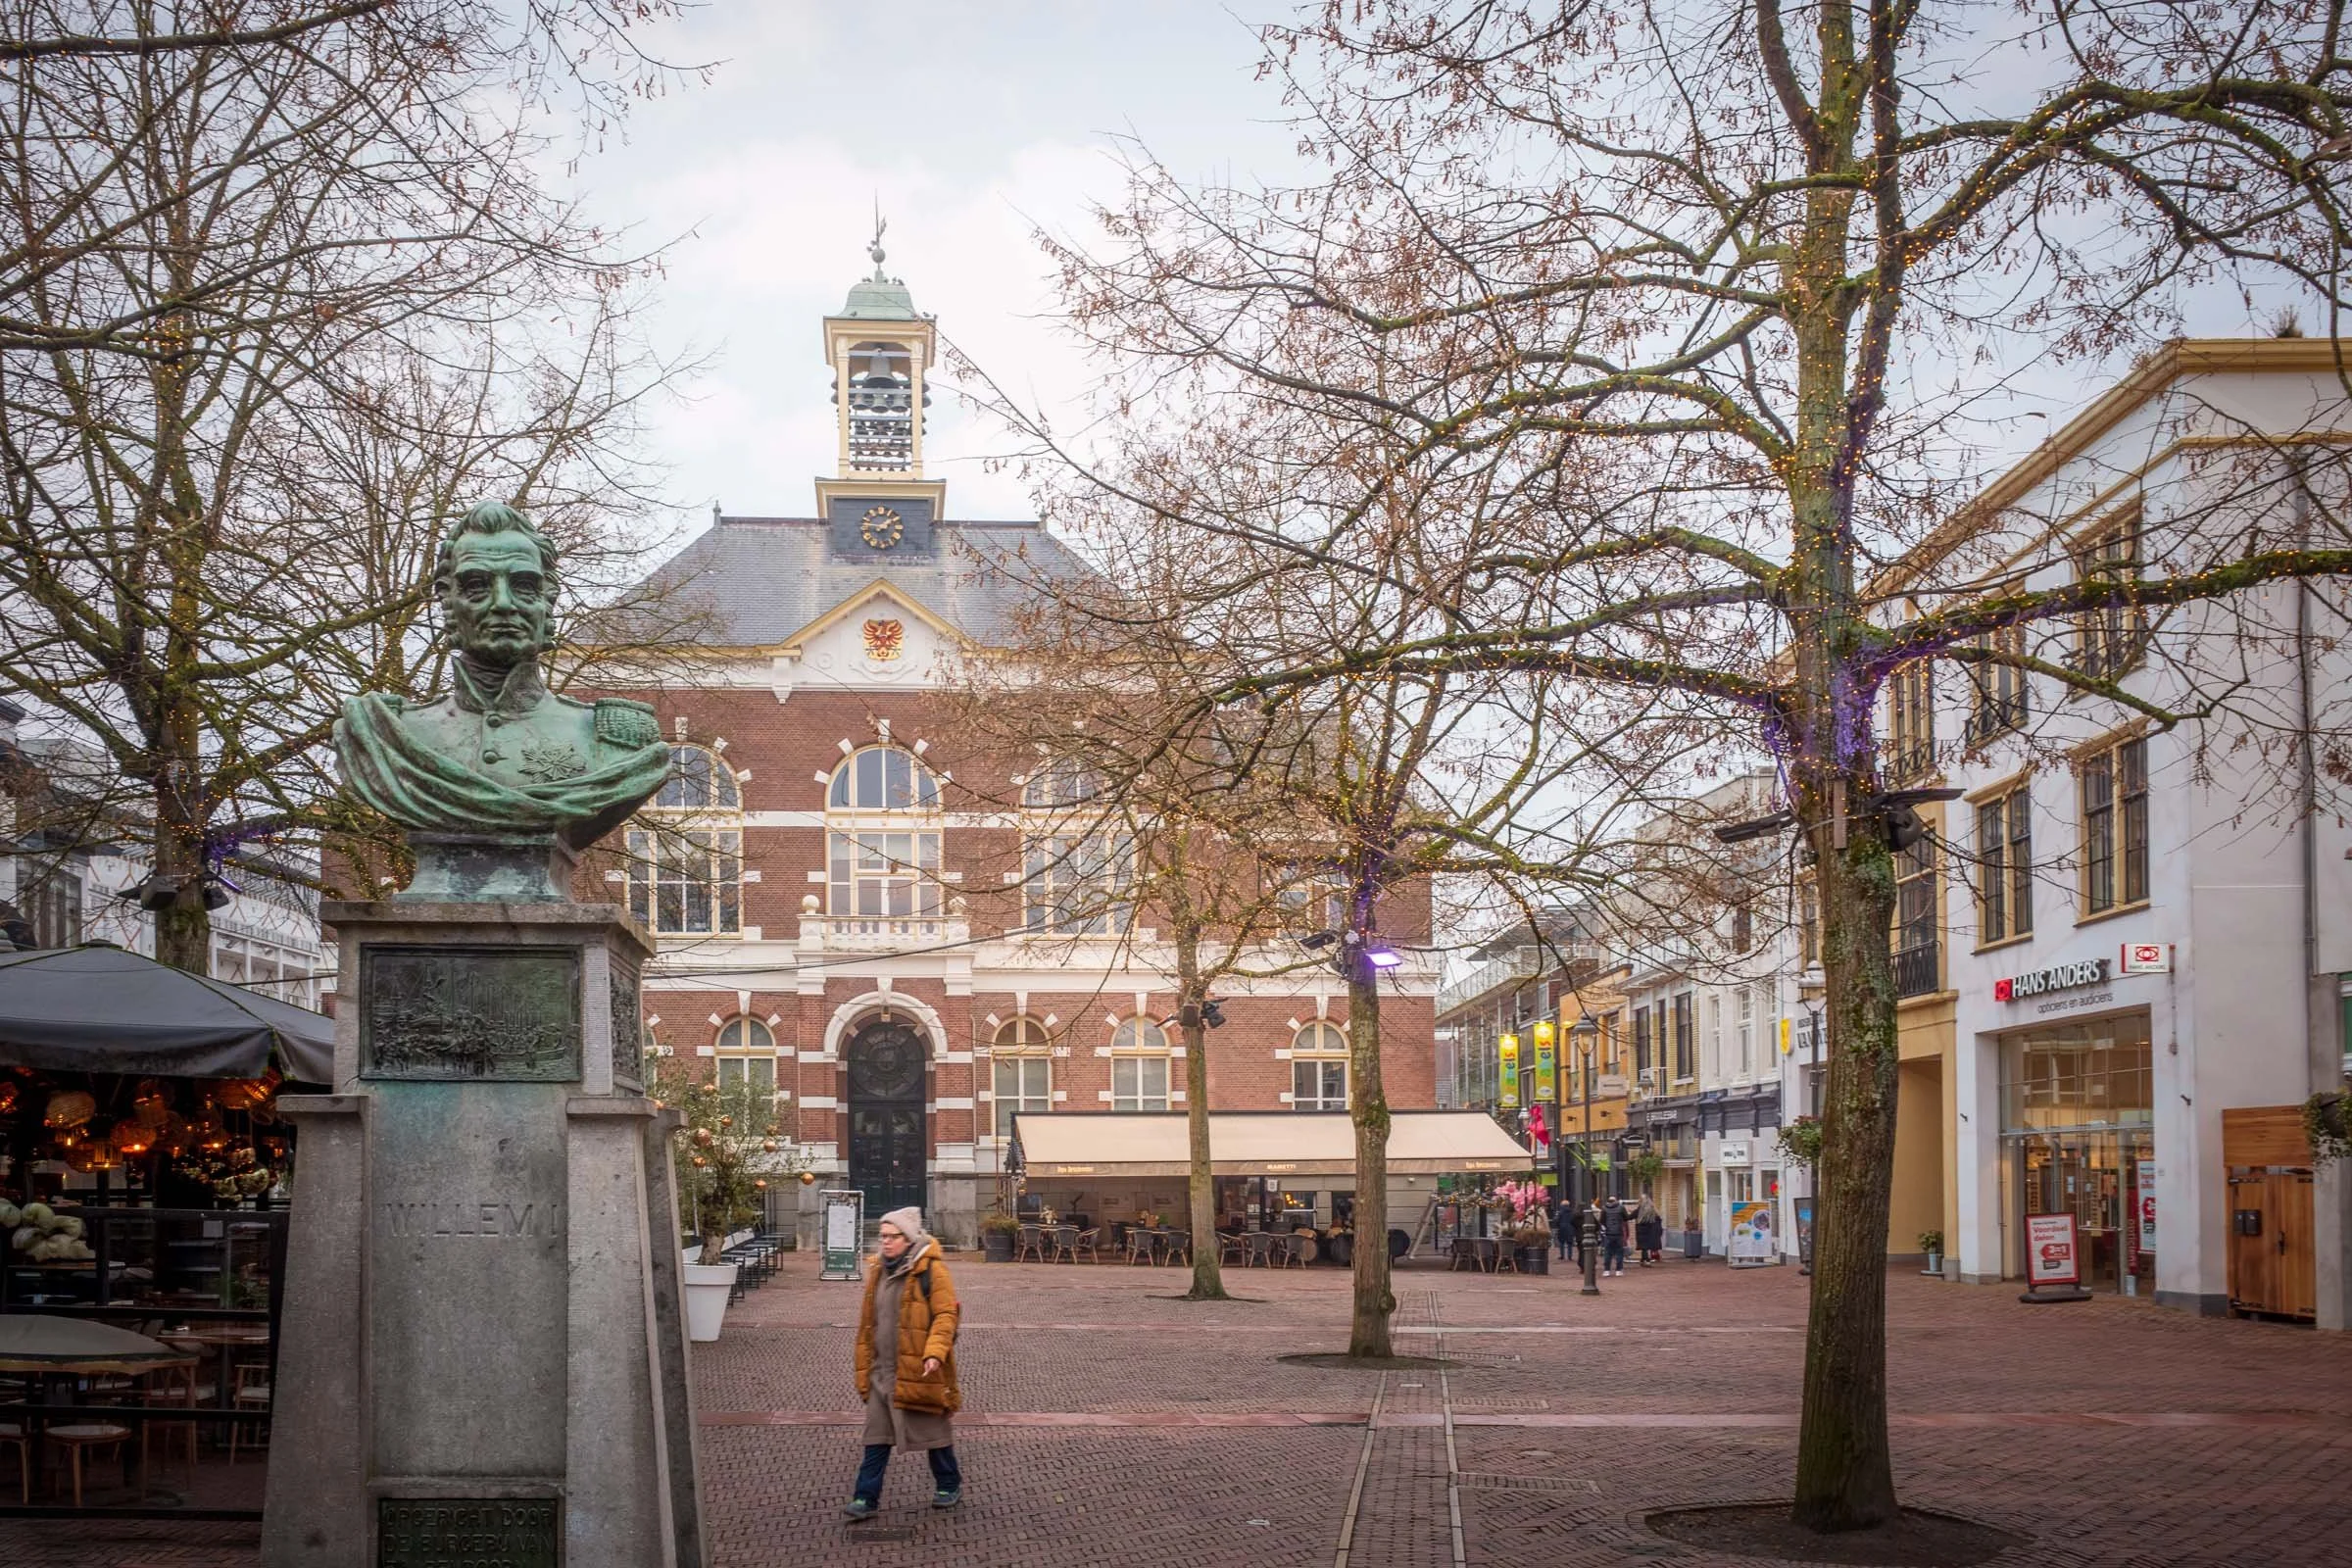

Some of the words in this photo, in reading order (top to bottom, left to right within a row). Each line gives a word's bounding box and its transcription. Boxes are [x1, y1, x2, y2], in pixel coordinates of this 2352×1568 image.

[2012, 969, 2046, 998] HANS
[2047, 958, 2101, 990] ANDERS
[2037, 999, 2069, 1014] opticiens
[2069, 999, 2079, 1009] en
[2080, 991, 2114, 1007] audiciens
[386, 1203, 534, 1237] WILLEM
[551, 1203, 558, 1238] I
[384, 1507, 495, 1527] OPGERICHT
[501, 1507, 553, 1527] DOOR
[383, 1534, 411, 1552] DE
[516, 1534, 555, 1553] VAN
